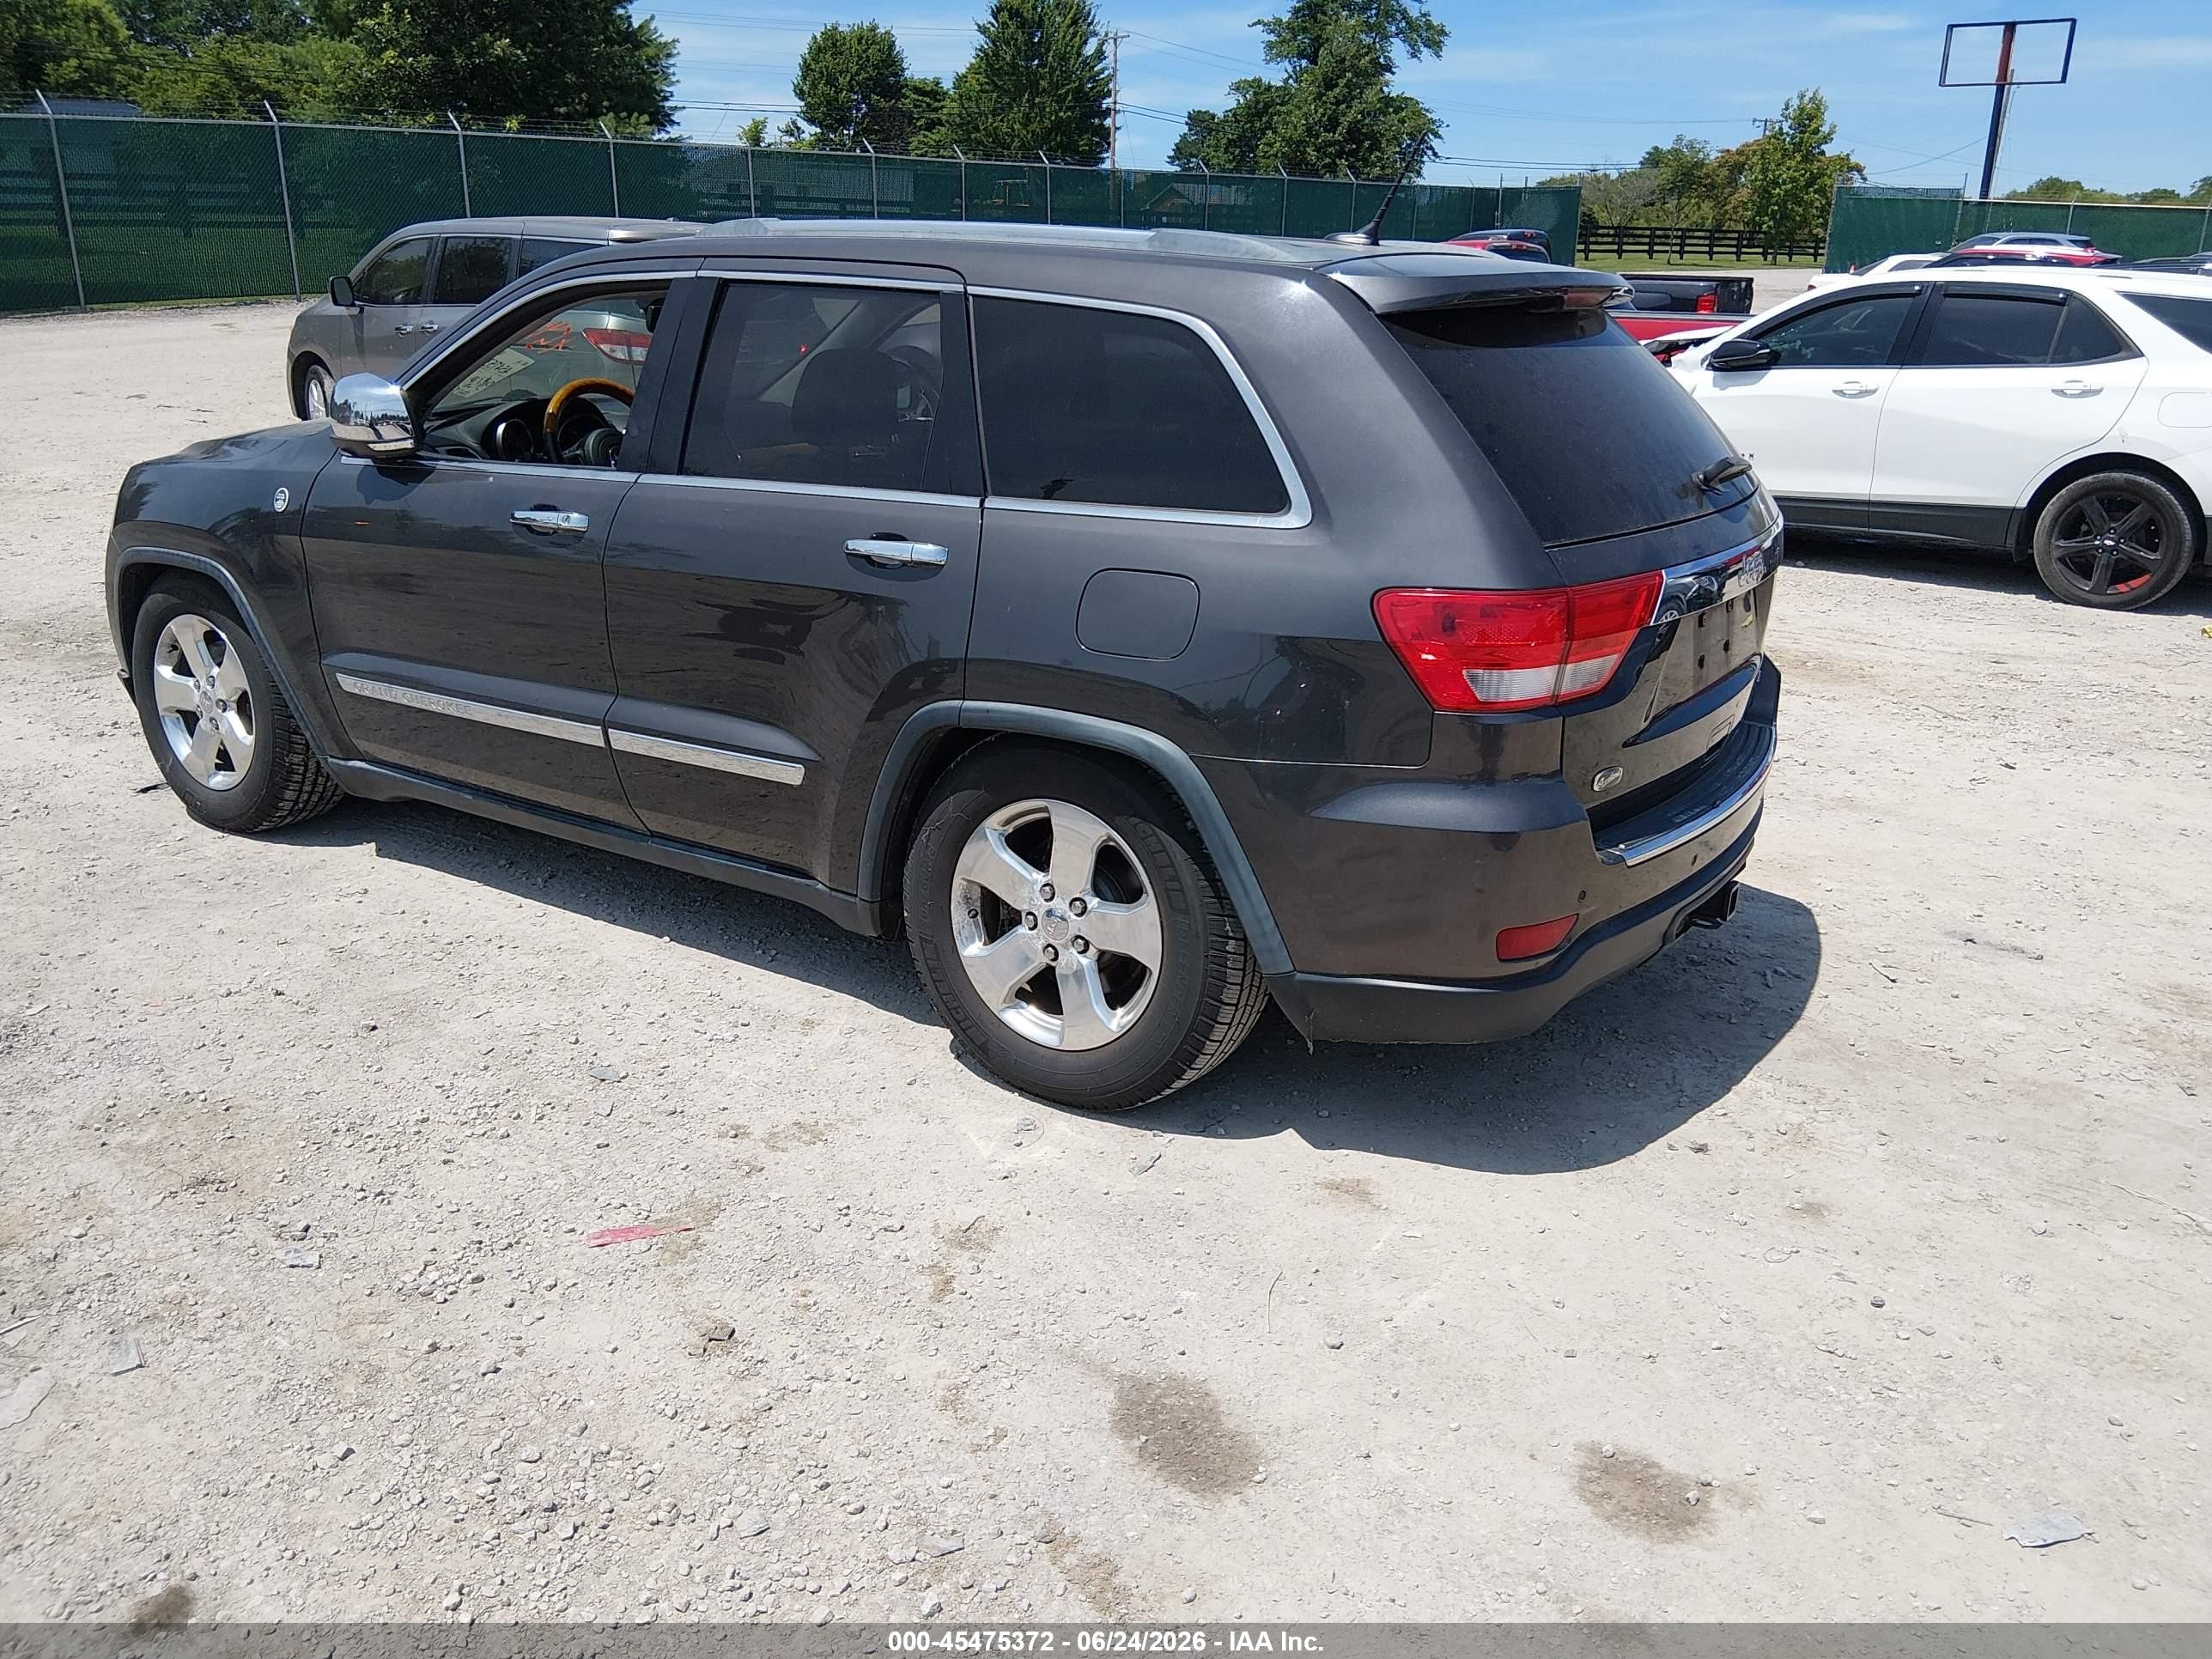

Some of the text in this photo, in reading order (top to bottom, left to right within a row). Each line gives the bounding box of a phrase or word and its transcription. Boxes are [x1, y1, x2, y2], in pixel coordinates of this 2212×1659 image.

[354, 683, 474, 718] GRAND CHEROKEE
[921, 940, 987, 1047] MICHELIN
